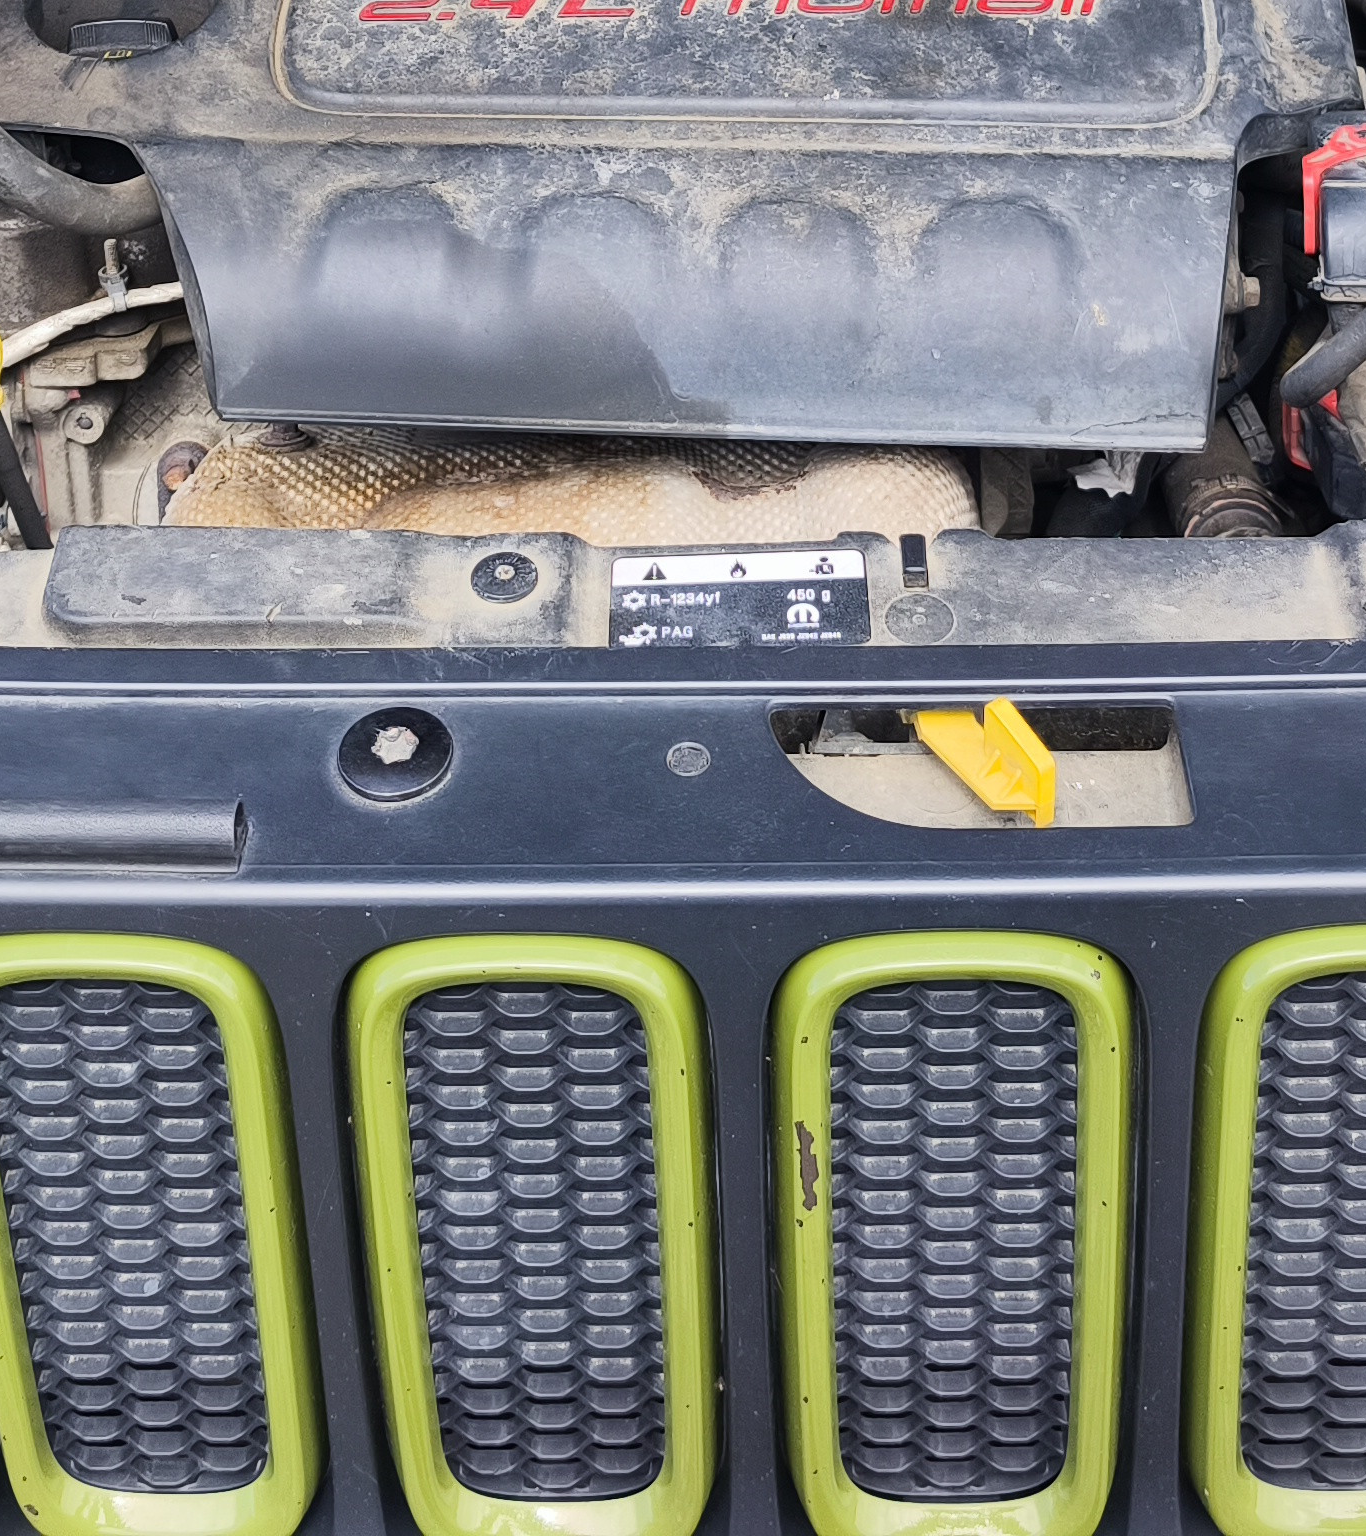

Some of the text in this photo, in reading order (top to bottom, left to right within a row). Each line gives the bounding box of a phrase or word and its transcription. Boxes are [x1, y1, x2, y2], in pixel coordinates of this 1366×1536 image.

[786, 588, 831, 603] 450 g
[660, 625, 694, 640] PAG
